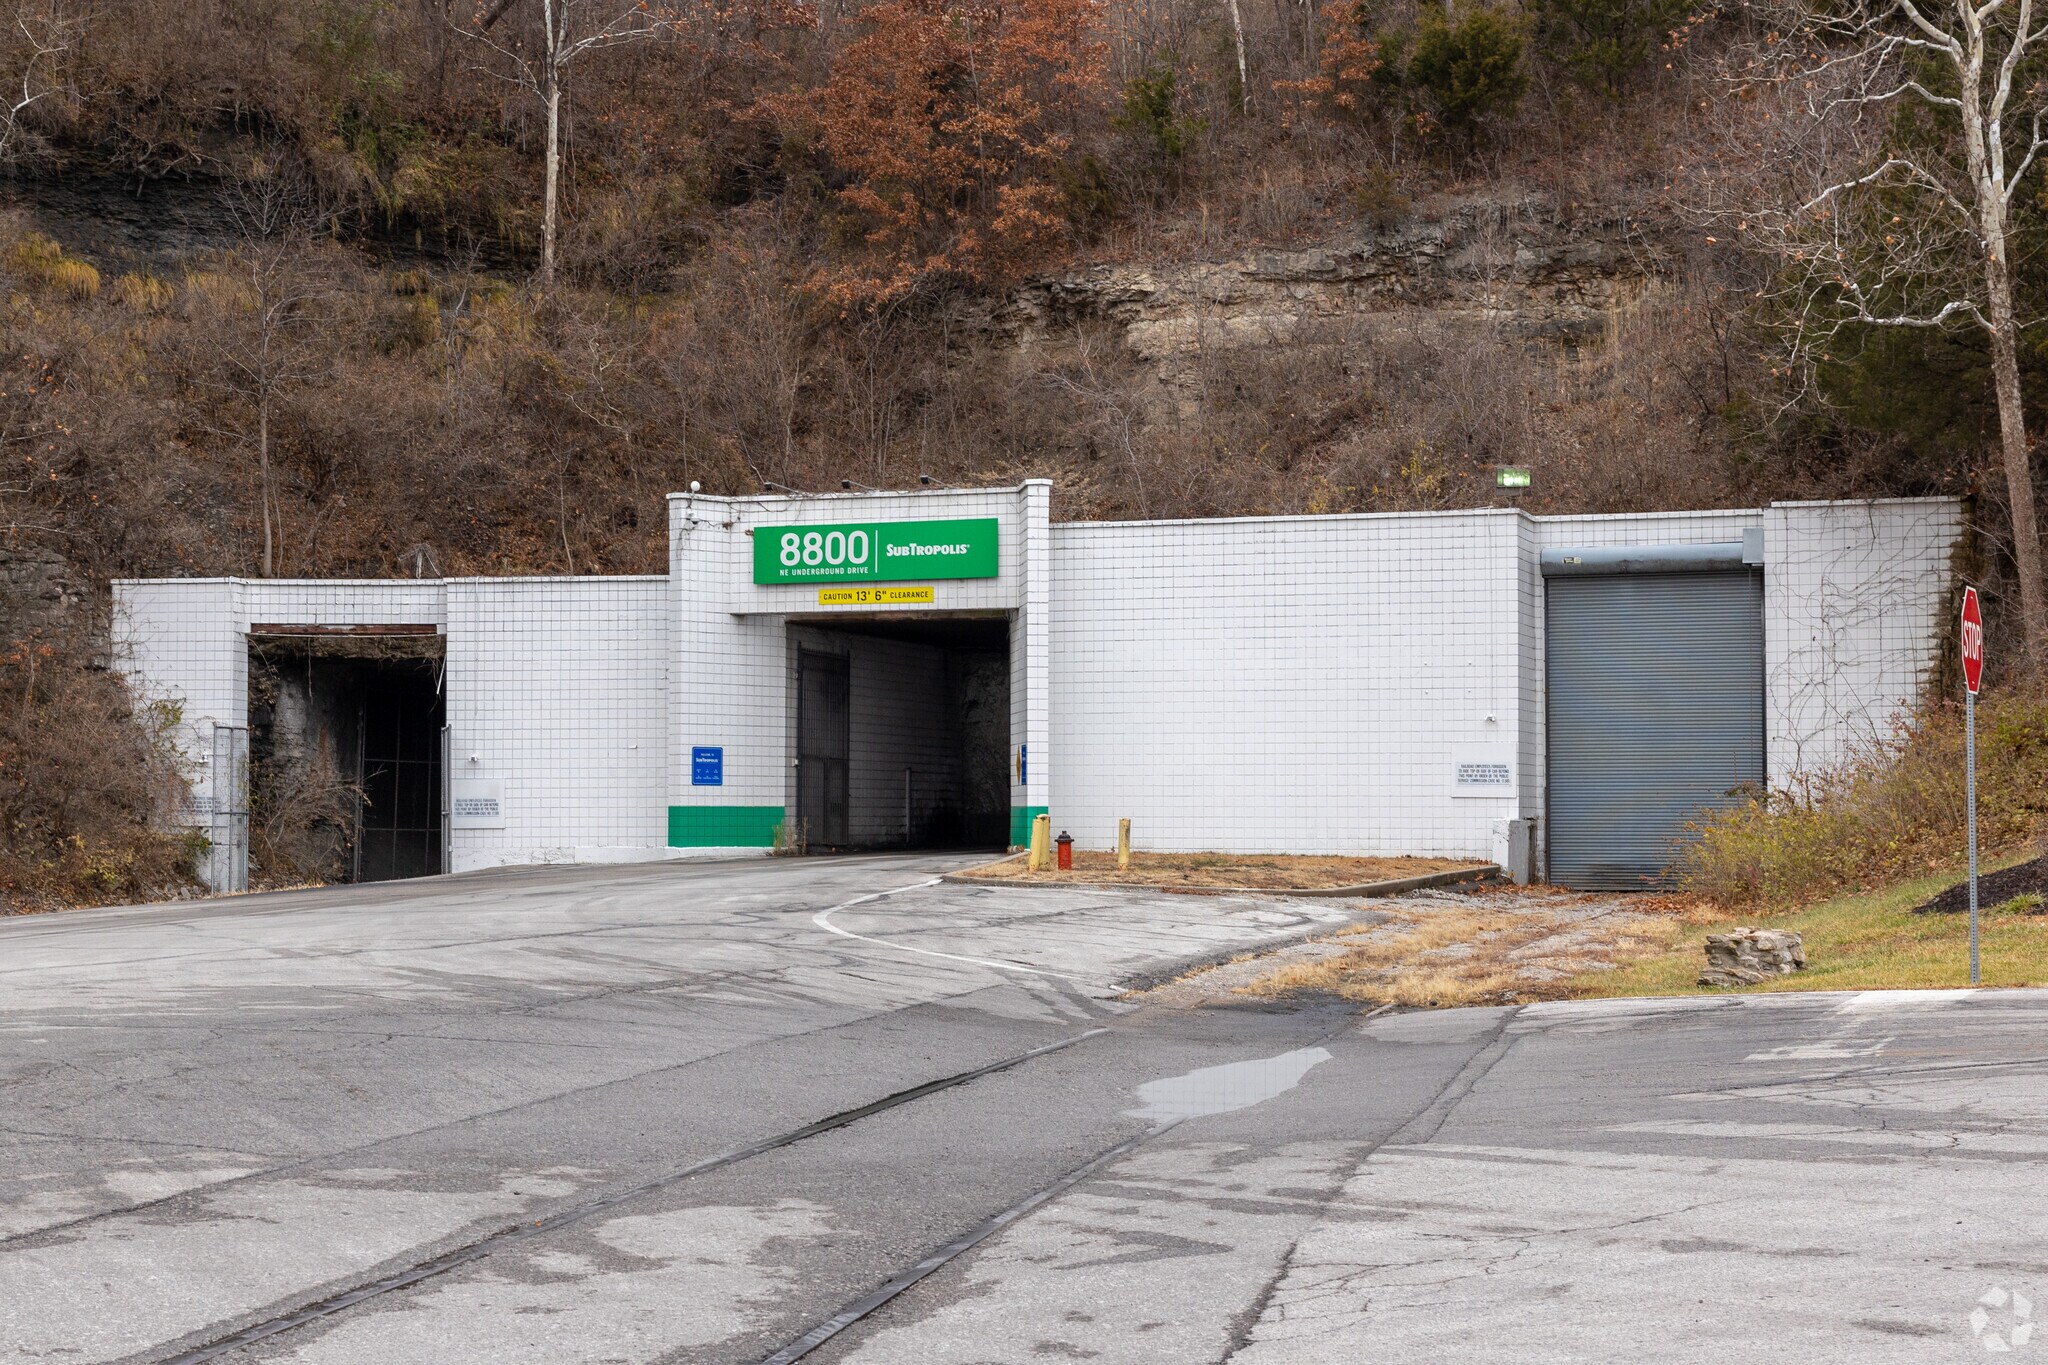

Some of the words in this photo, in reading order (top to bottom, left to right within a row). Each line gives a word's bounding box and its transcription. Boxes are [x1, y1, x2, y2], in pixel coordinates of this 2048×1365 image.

[780, 530, 869, 567] 8800
[792, 567, 845, 576] UNDERGROUND
[847, 566, 869, 575] DRIVE
[823, 592, 853, 601] CAUTION
[856, 590, 871, 602] 13'
[875, 589, 887, 601] 6"
[890, 590, 929, 599] CLEARANCE
[1963, 620, 1981, 661] STOP
